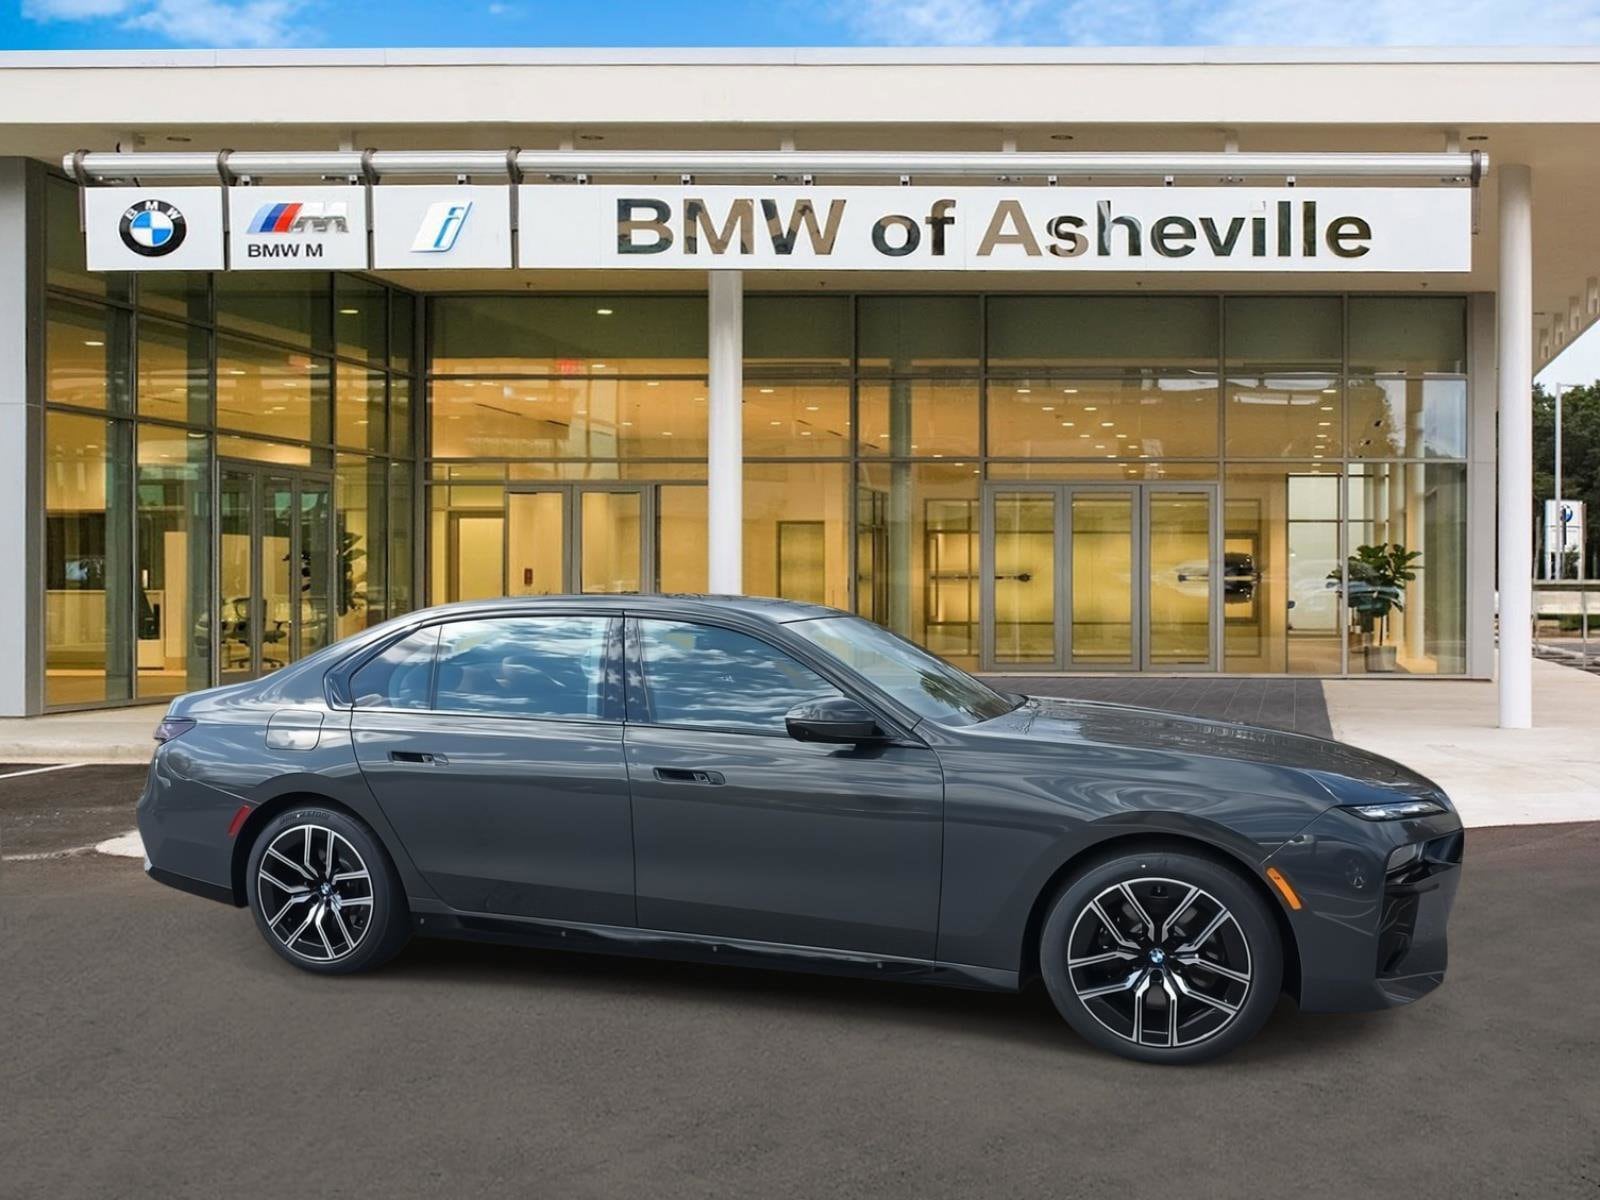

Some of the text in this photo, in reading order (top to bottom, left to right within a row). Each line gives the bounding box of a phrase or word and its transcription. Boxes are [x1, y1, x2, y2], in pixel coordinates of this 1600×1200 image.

[125, 200, 182, 220] BMW
[616, 198, 1372, 258] BMW of Asheville
[247, 243, 323, 258] BMW M
